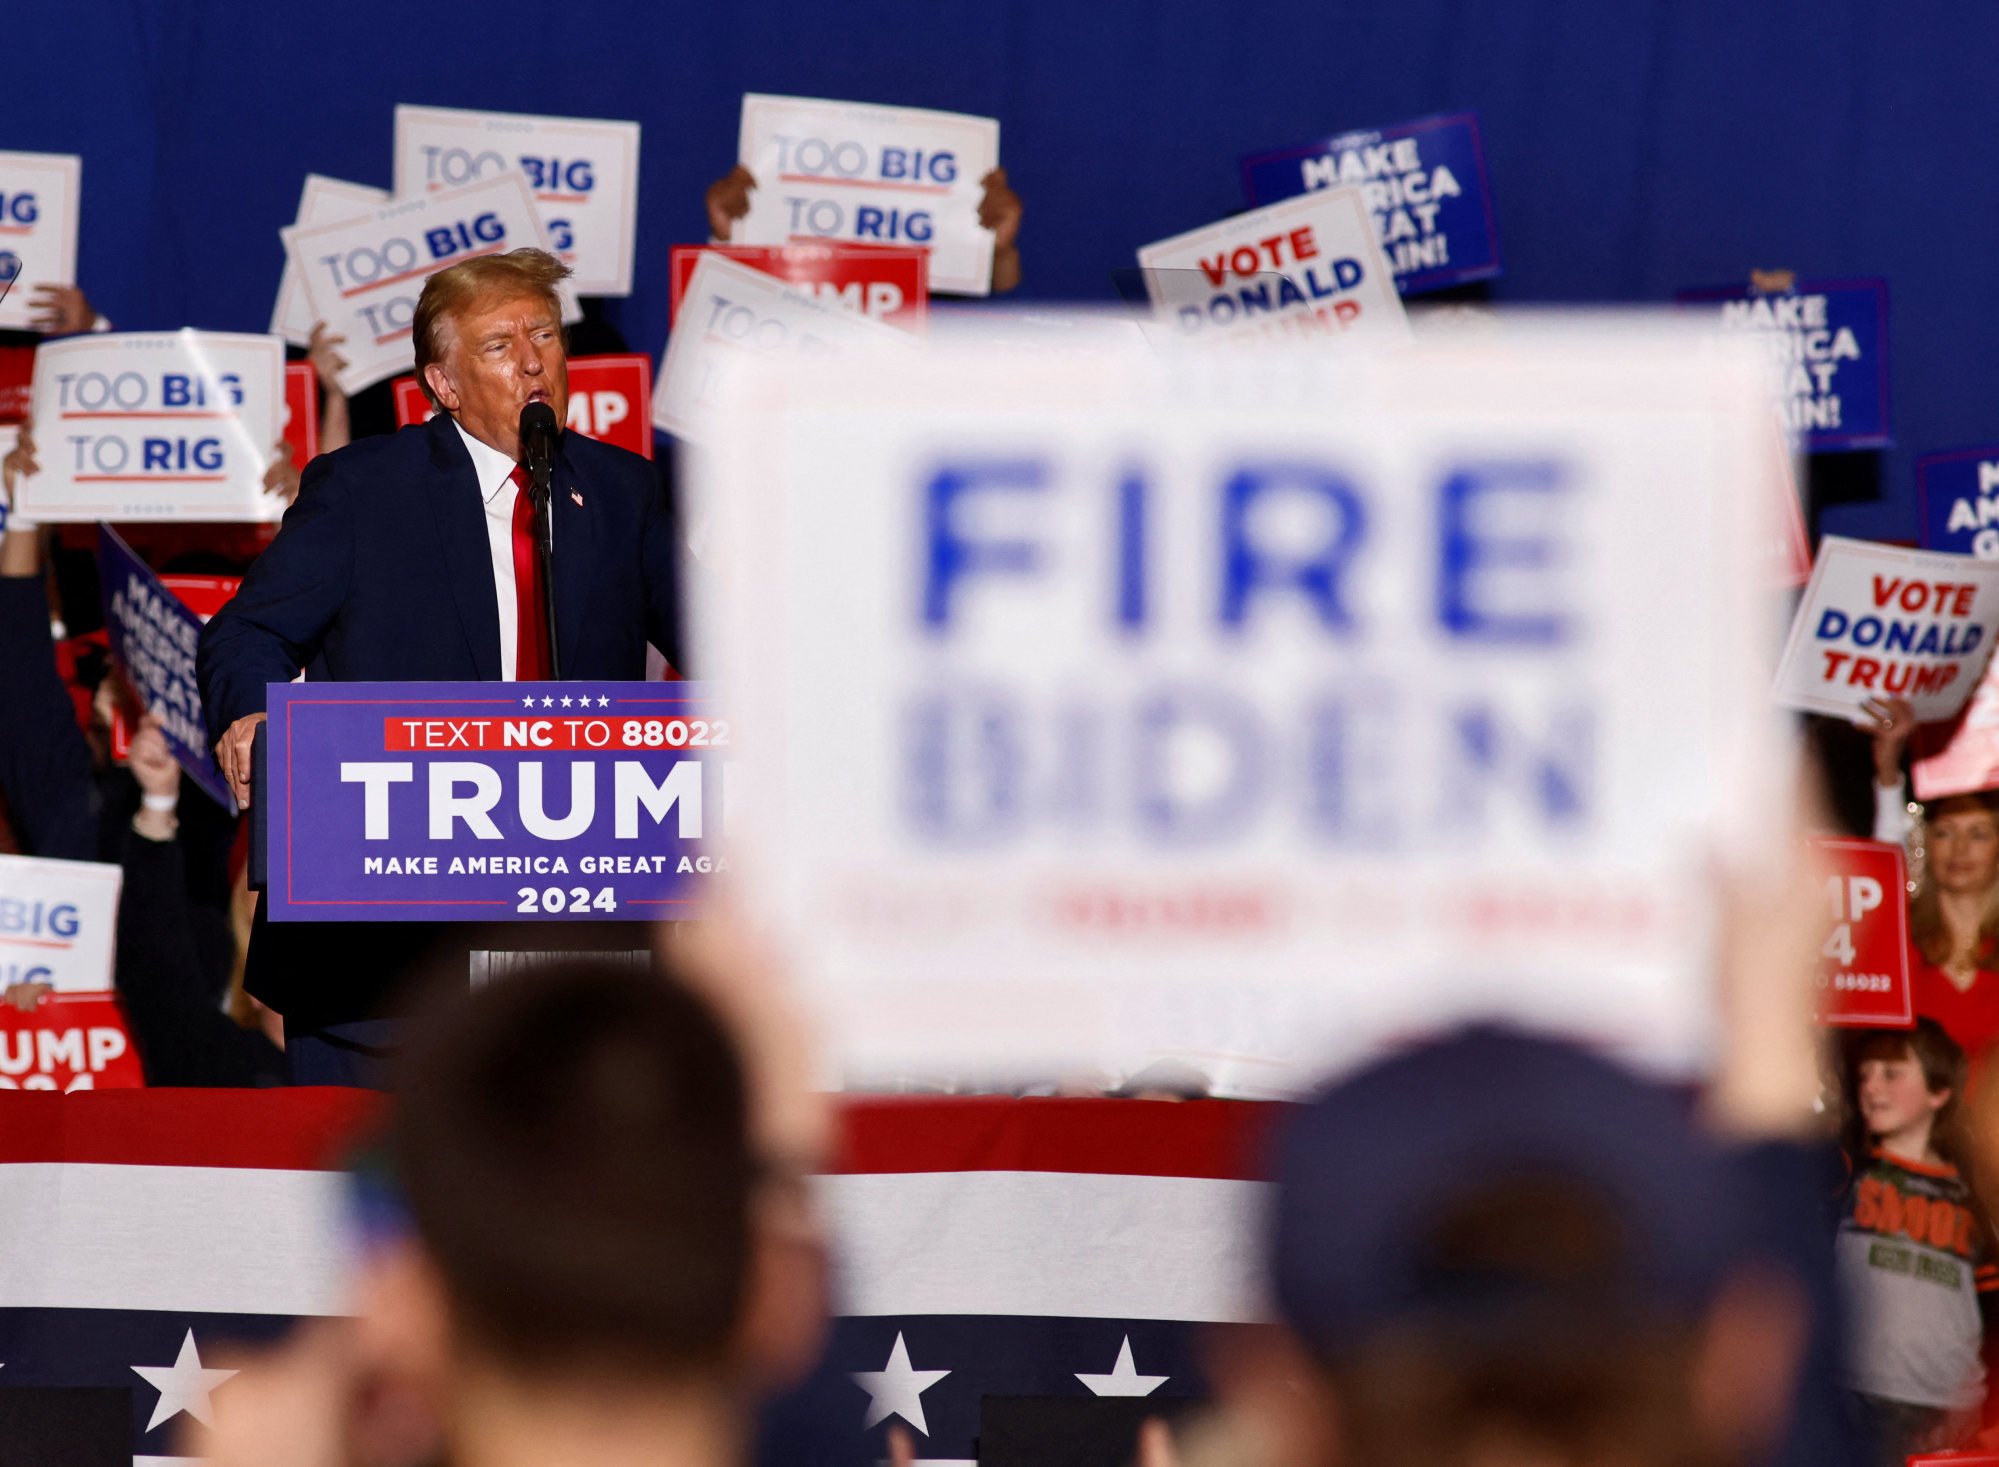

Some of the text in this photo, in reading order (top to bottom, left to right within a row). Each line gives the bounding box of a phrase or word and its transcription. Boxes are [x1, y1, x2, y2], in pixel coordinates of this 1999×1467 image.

[521, 156, 594, 193] BIG
[770, 134, 958, 184] TOO BIG
[1302, 138, 1422, 190] MAKE
[0, 190, 38, 223] IG
[784, 196, 936, 242] TO RIG
[321, 237, 417, 288] TOO
[425, 212, 506, 260] BIG
[1198, 224, 1320, 289] VOTE
[1176, 257, 1365, 336] DONALD
[55, 371, 149, 412] TOO
[161, 374, 244, 408] BIG
[66, 434, 225, 474] TO RIG
[914, 450, 1582, 644] FIRE
[1871, 573, 1977, 617] VOTE
[1814, 608, 1985, 657] DONALD
[1821, 649, 1961, 697] TRUMP
[403, 720, 730, 747] TEXT NC TO 88022
[340, 761, 735, 841] TRUM
[364, 856, 730, 875] MAKE AMERICA GREAT AGA
[516, 887, 618, 913] 2024
